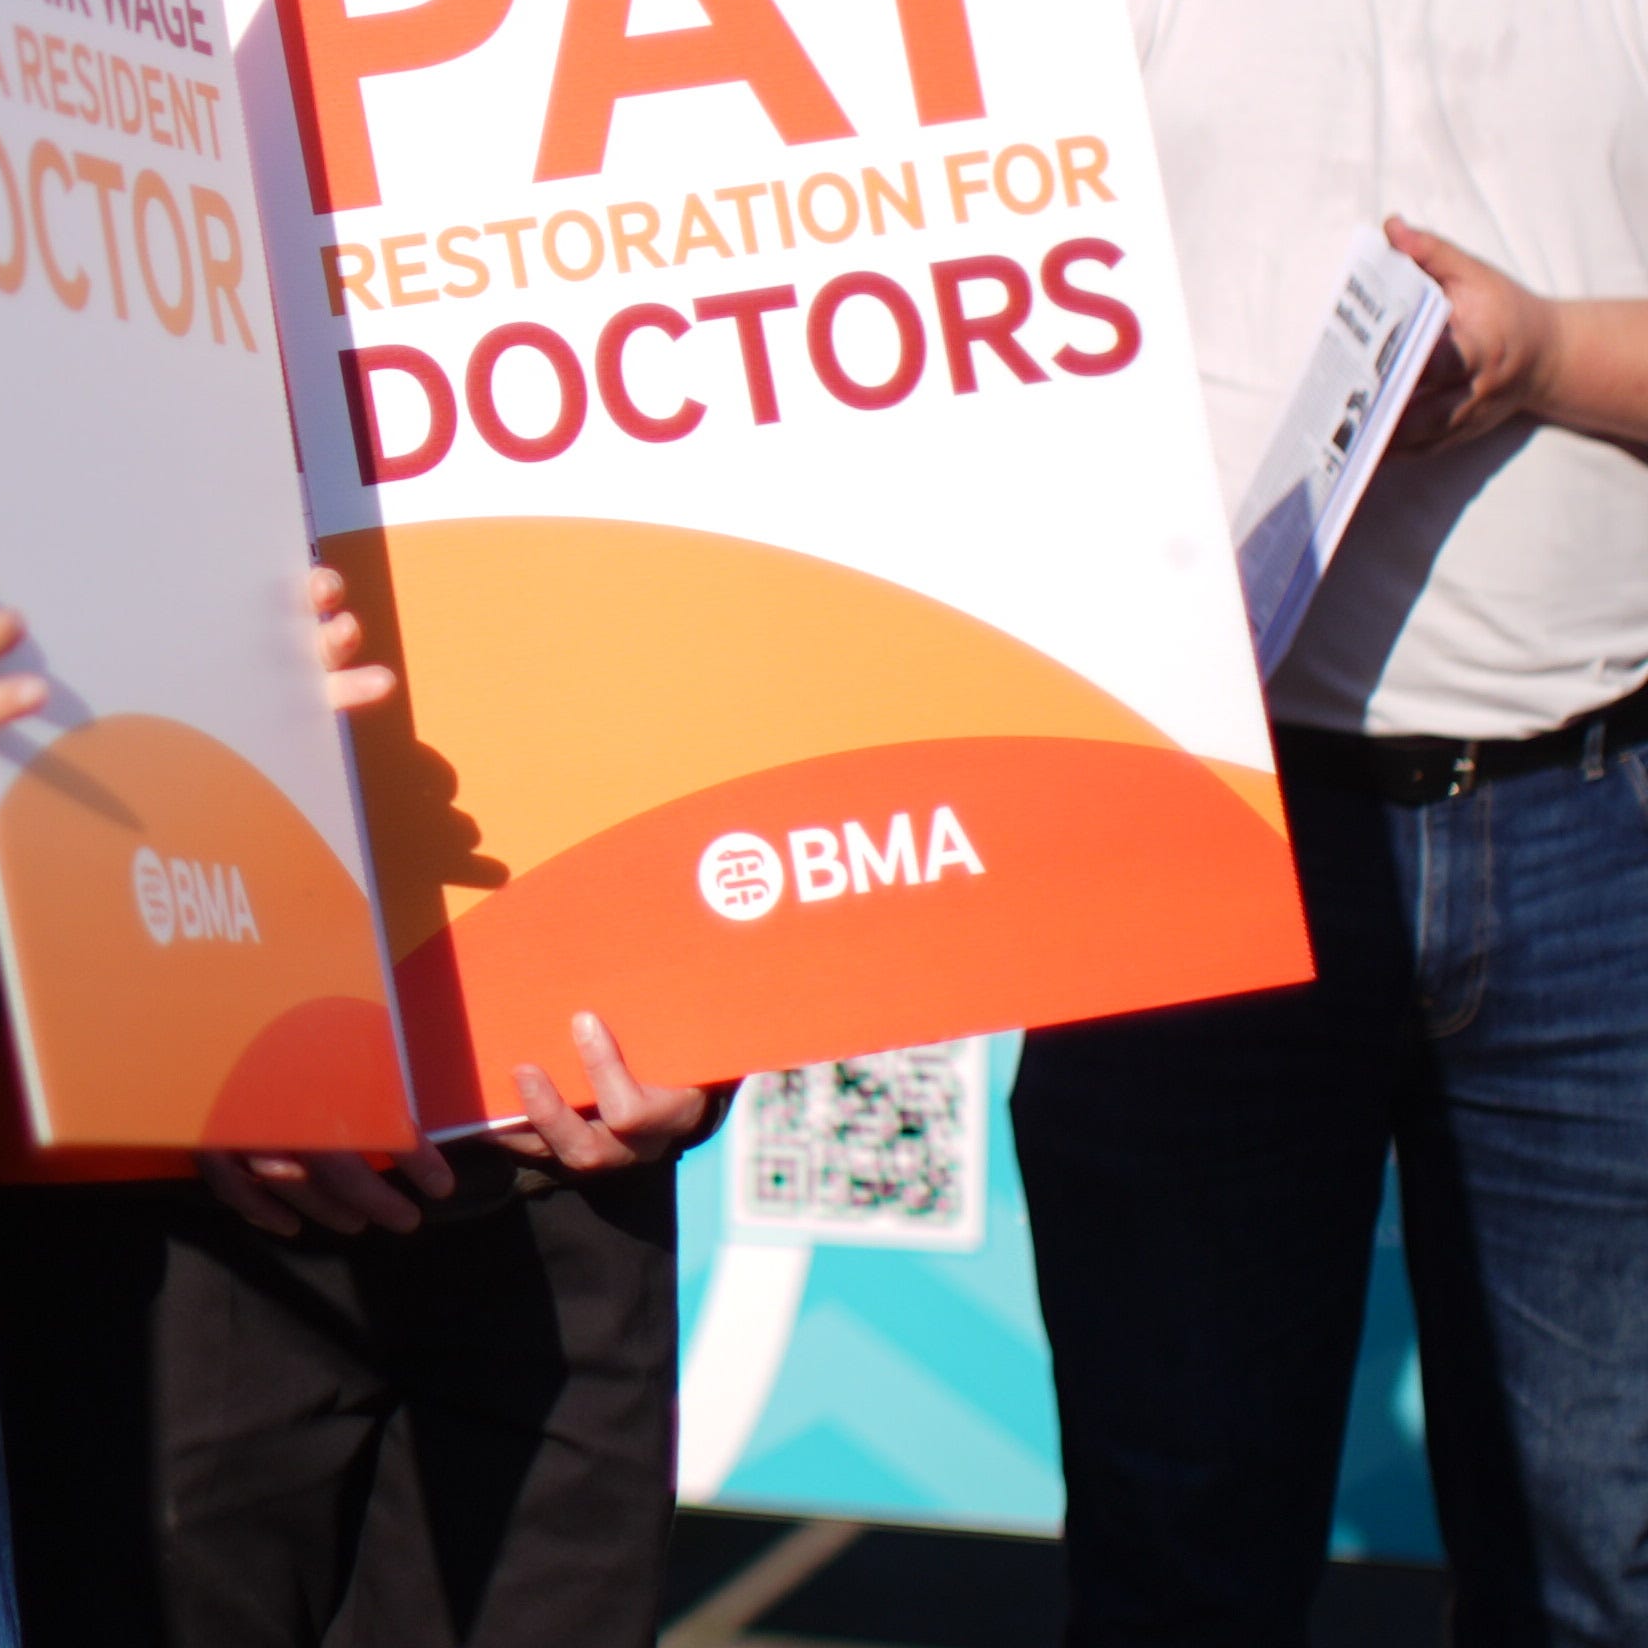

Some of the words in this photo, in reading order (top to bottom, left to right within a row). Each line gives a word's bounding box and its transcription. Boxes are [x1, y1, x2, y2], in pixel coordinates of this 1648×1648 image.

[12, 23, 222, 161] RESIDENT
[319, 160, 926, 317] RESTORATION
[943, 133, 1119, 225] FOR
[337, 236, 1143, 487] DOCTORS
[167, 857, 261, 945] BMA
[788, 804, 986, 906] BMA
